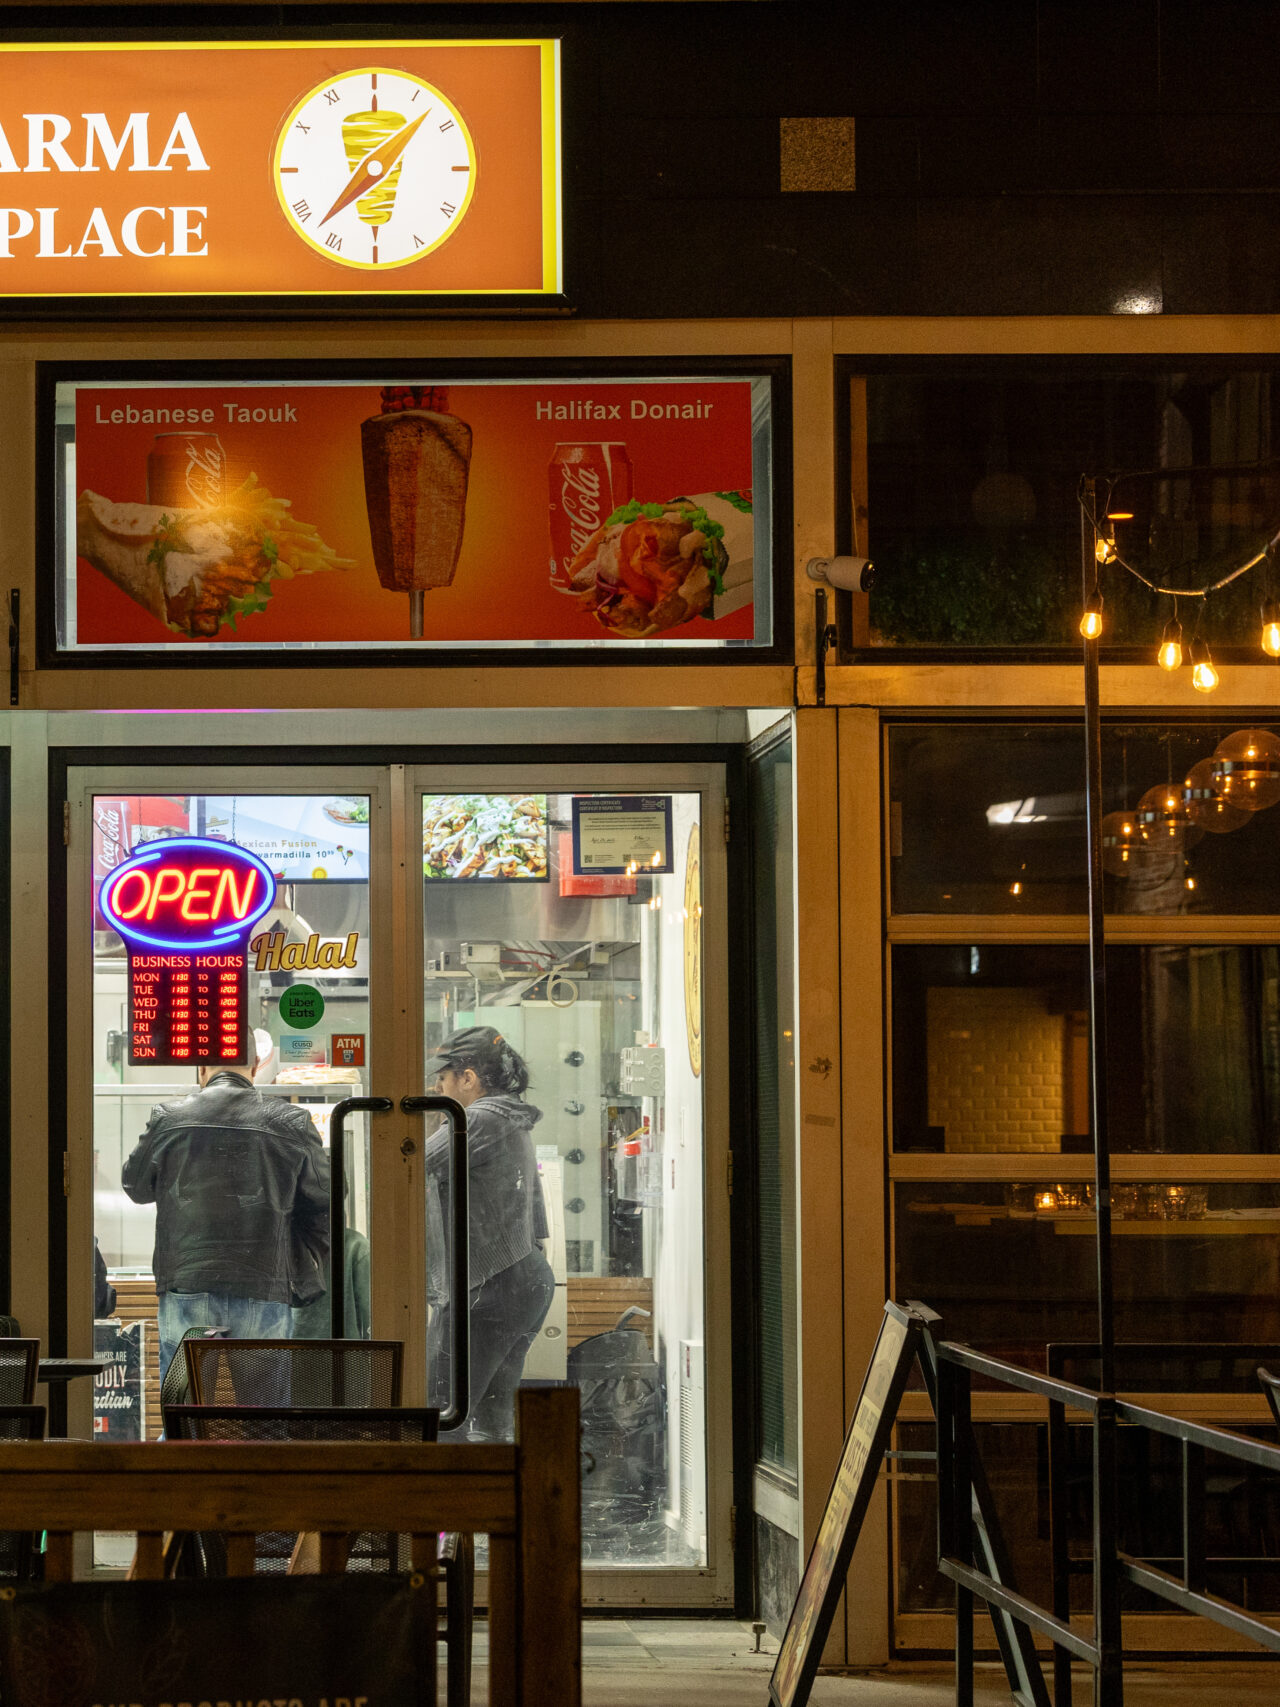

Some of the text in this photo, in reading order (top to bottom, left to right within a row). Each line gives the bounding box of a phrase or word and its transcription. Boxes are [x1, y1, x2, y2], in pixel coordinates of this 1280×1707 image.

[323, 88, 341, 106] XI
[295, 120, 311, 135] X
[439, 119, 455, 133] II
[292, 199, 313, 223] VIII
[439, 201, 456, 219] IV
[324, 232, 343, 252] VII
[412, 234, 425, 249] V
[95, 403, 298, 425] Lebanese Taouk
[536, 399, 714, 421] Halifax Donair
[111, 867, 258, 921] OPEN
[251, 932, 359, 971] Halal
[132, 956, 243, 968] BUSINESS HOURS
[133, 973, 160, 982] MON
[133, 985, 153, 994] TUE
[133, 998, 158, 1007] WED
[289, 998, 315, 1007] Uber
[133, 1010, 156, 1019] THU
[289, 1008, 315, 1017] Eats
[133, 1023, 149, 1032] FRI
[133, 1035, 152, 1044] SAT
[336, 1039, 361, 1048] ATM
[133, 1048, 156, 1057] SUN
[115, 1351, 127, 1362] ARE
